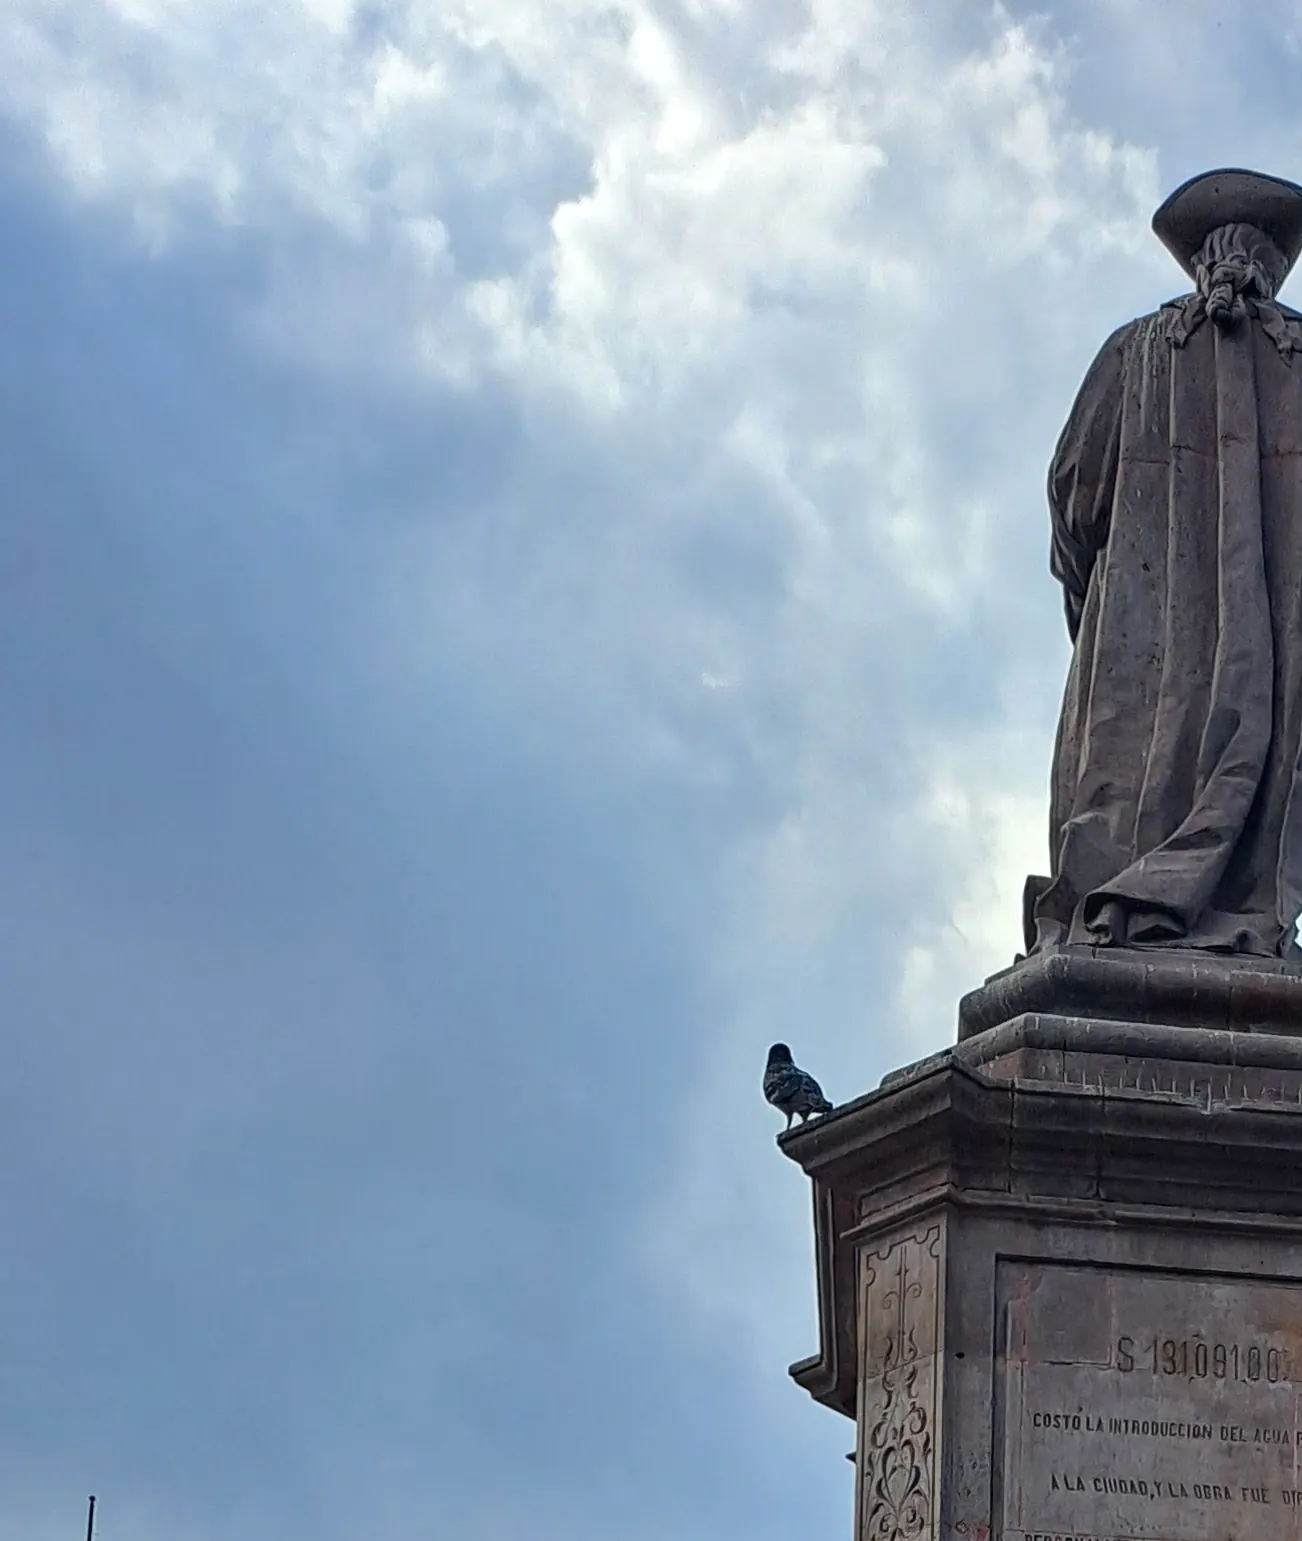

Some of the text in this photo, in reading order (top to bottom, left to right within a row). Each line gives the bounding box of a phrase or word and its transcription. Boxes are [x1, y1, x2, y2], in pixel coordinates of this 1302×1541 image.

[1086, 1416, 1104, 1433] LA
[1219, 1425, 1248, 1443] DEL
[1252, 1427, 1290, 1445] AGUA
[1051, 1473, 1060, 1491] A
[1063, 1474, 1086, 1492] LA
[1154, 1481, 1163, 1498] Y
[1167, 1482, 1188, 1499] LA
[1192, 1484, 1233, 1501] OBRA
[1241, 1487, 1271, 1505] FUE
